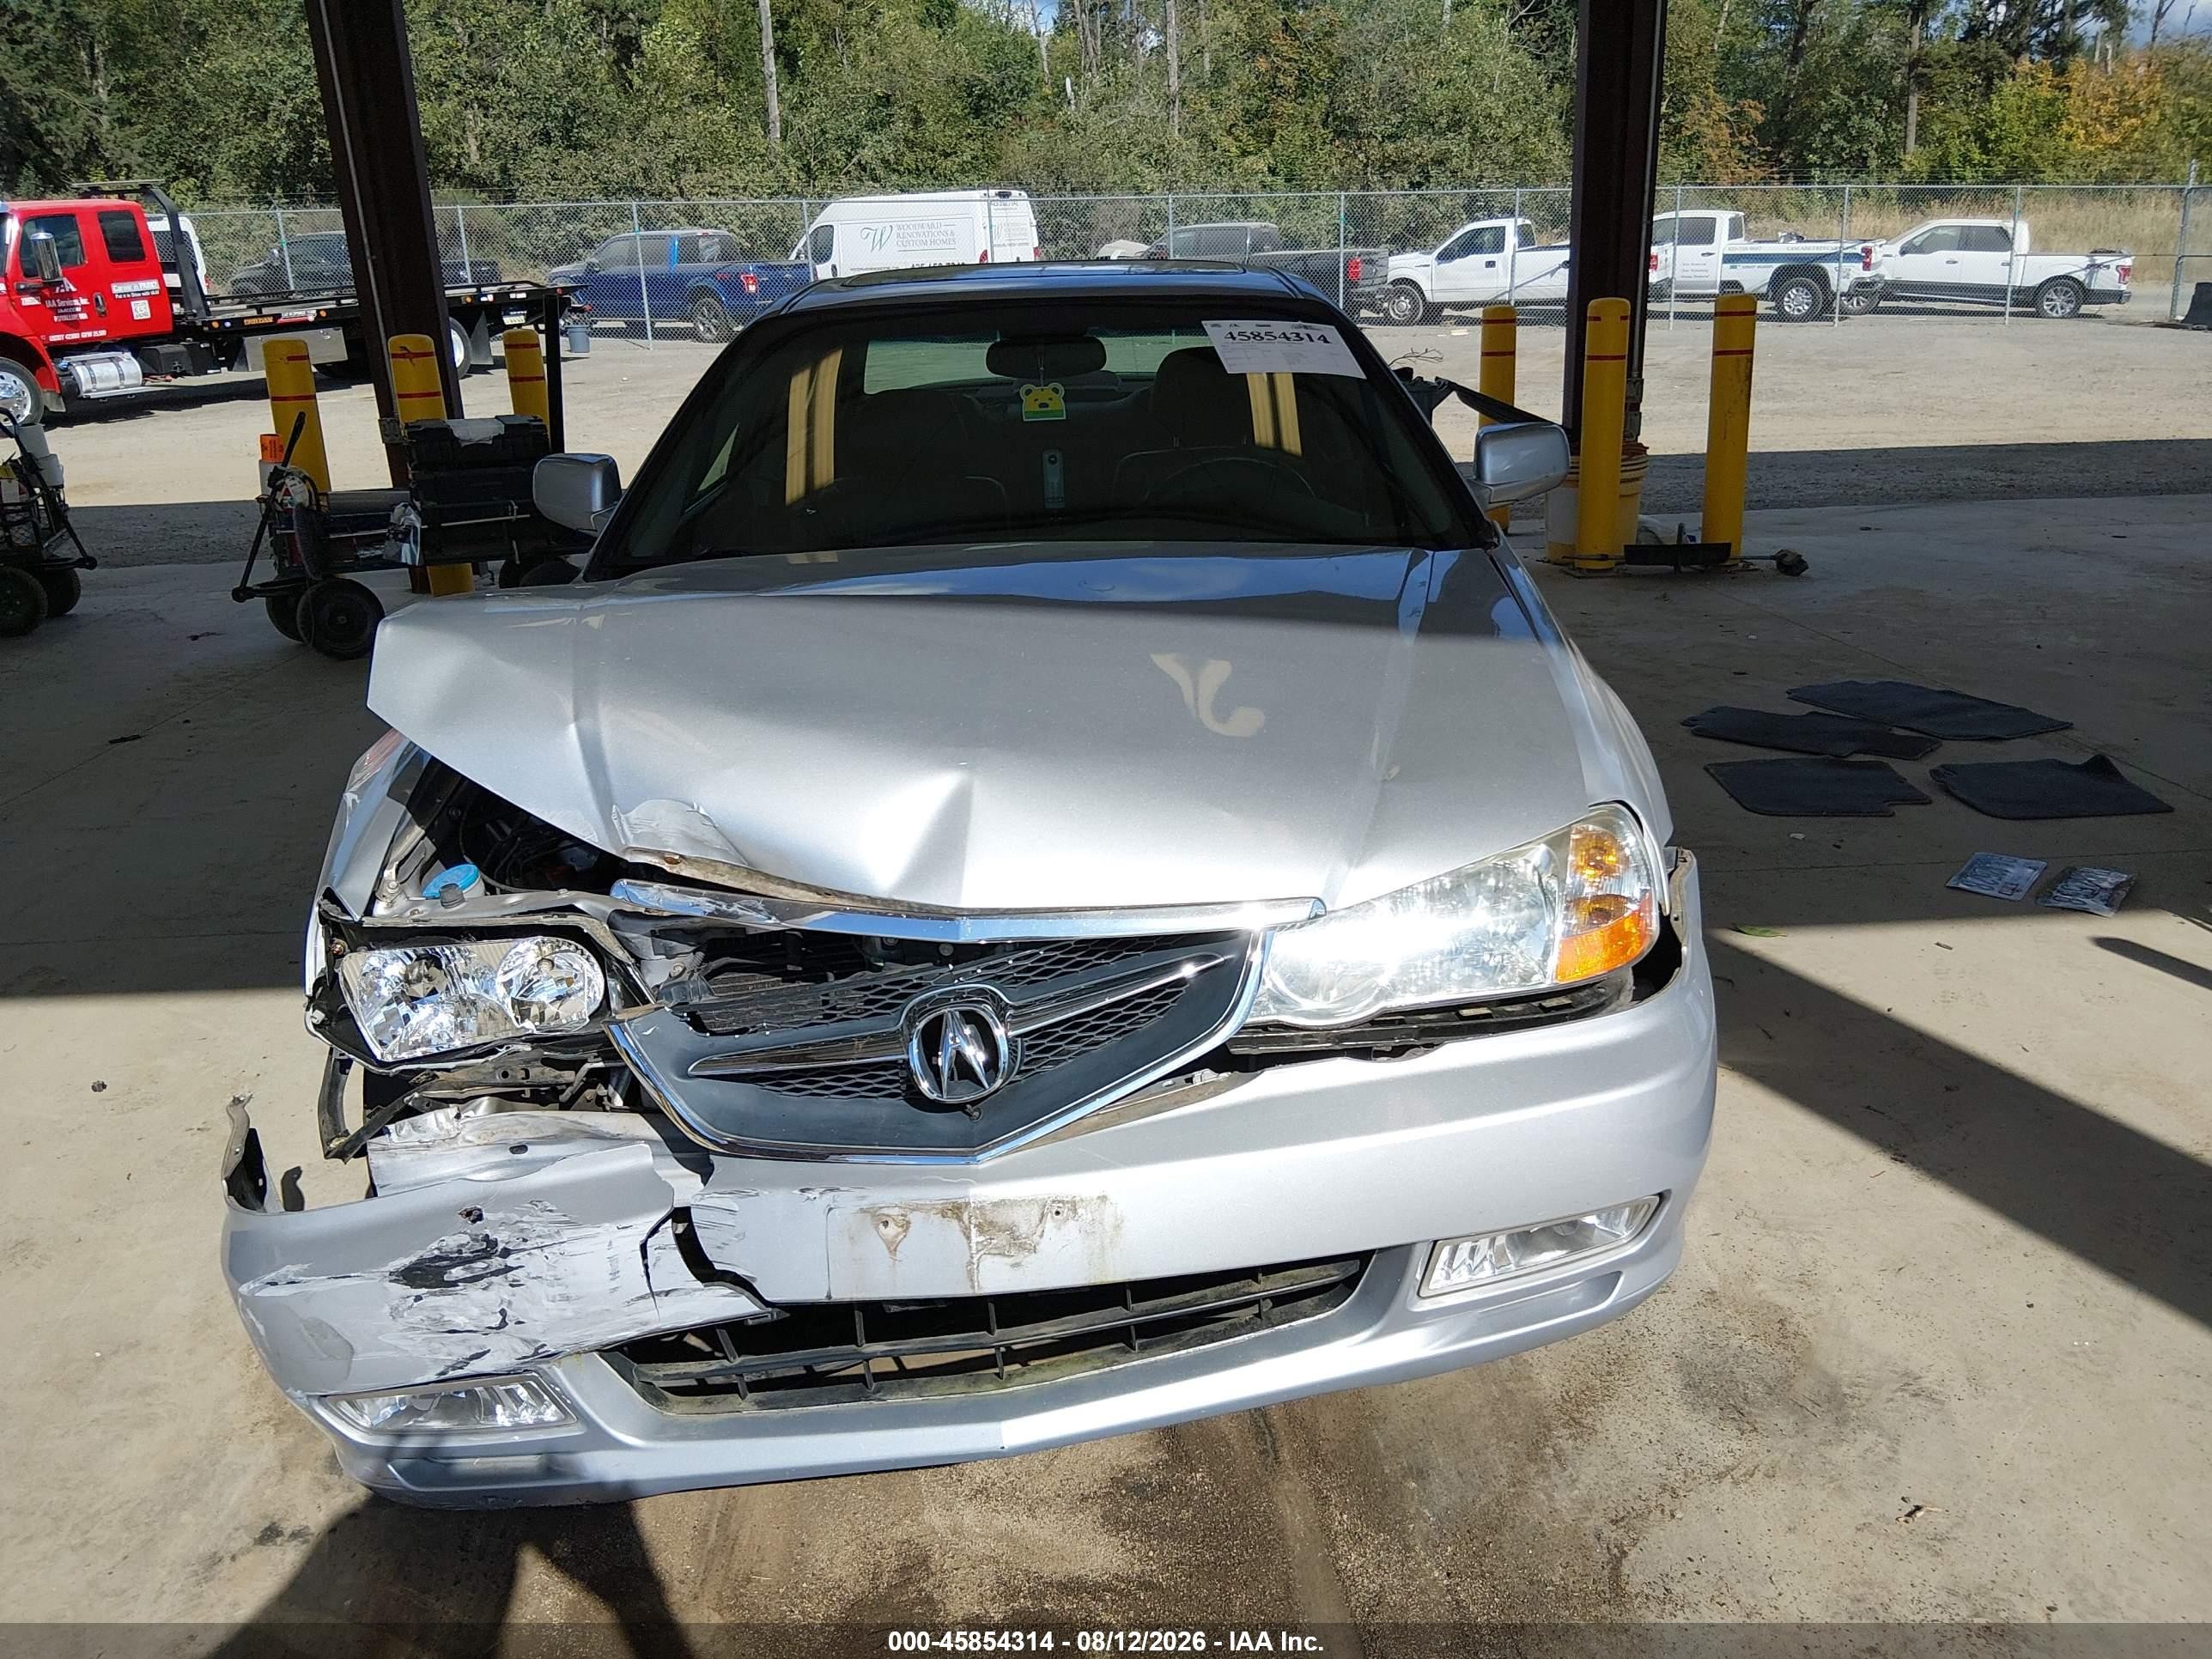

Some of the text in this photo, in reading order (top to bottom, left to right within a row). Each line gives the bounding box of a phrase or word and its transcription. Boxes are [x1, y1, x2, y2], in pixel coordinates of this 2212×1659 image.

[896, 222, 942, 232] WOODWARD
[860, 226, 893, 252] W
[896, 229, 949, 240] RENOVATIONS
[896, 237, 957, 247] CUSTOM HOMES
[1224, 331, 1333, 344] 45854314
